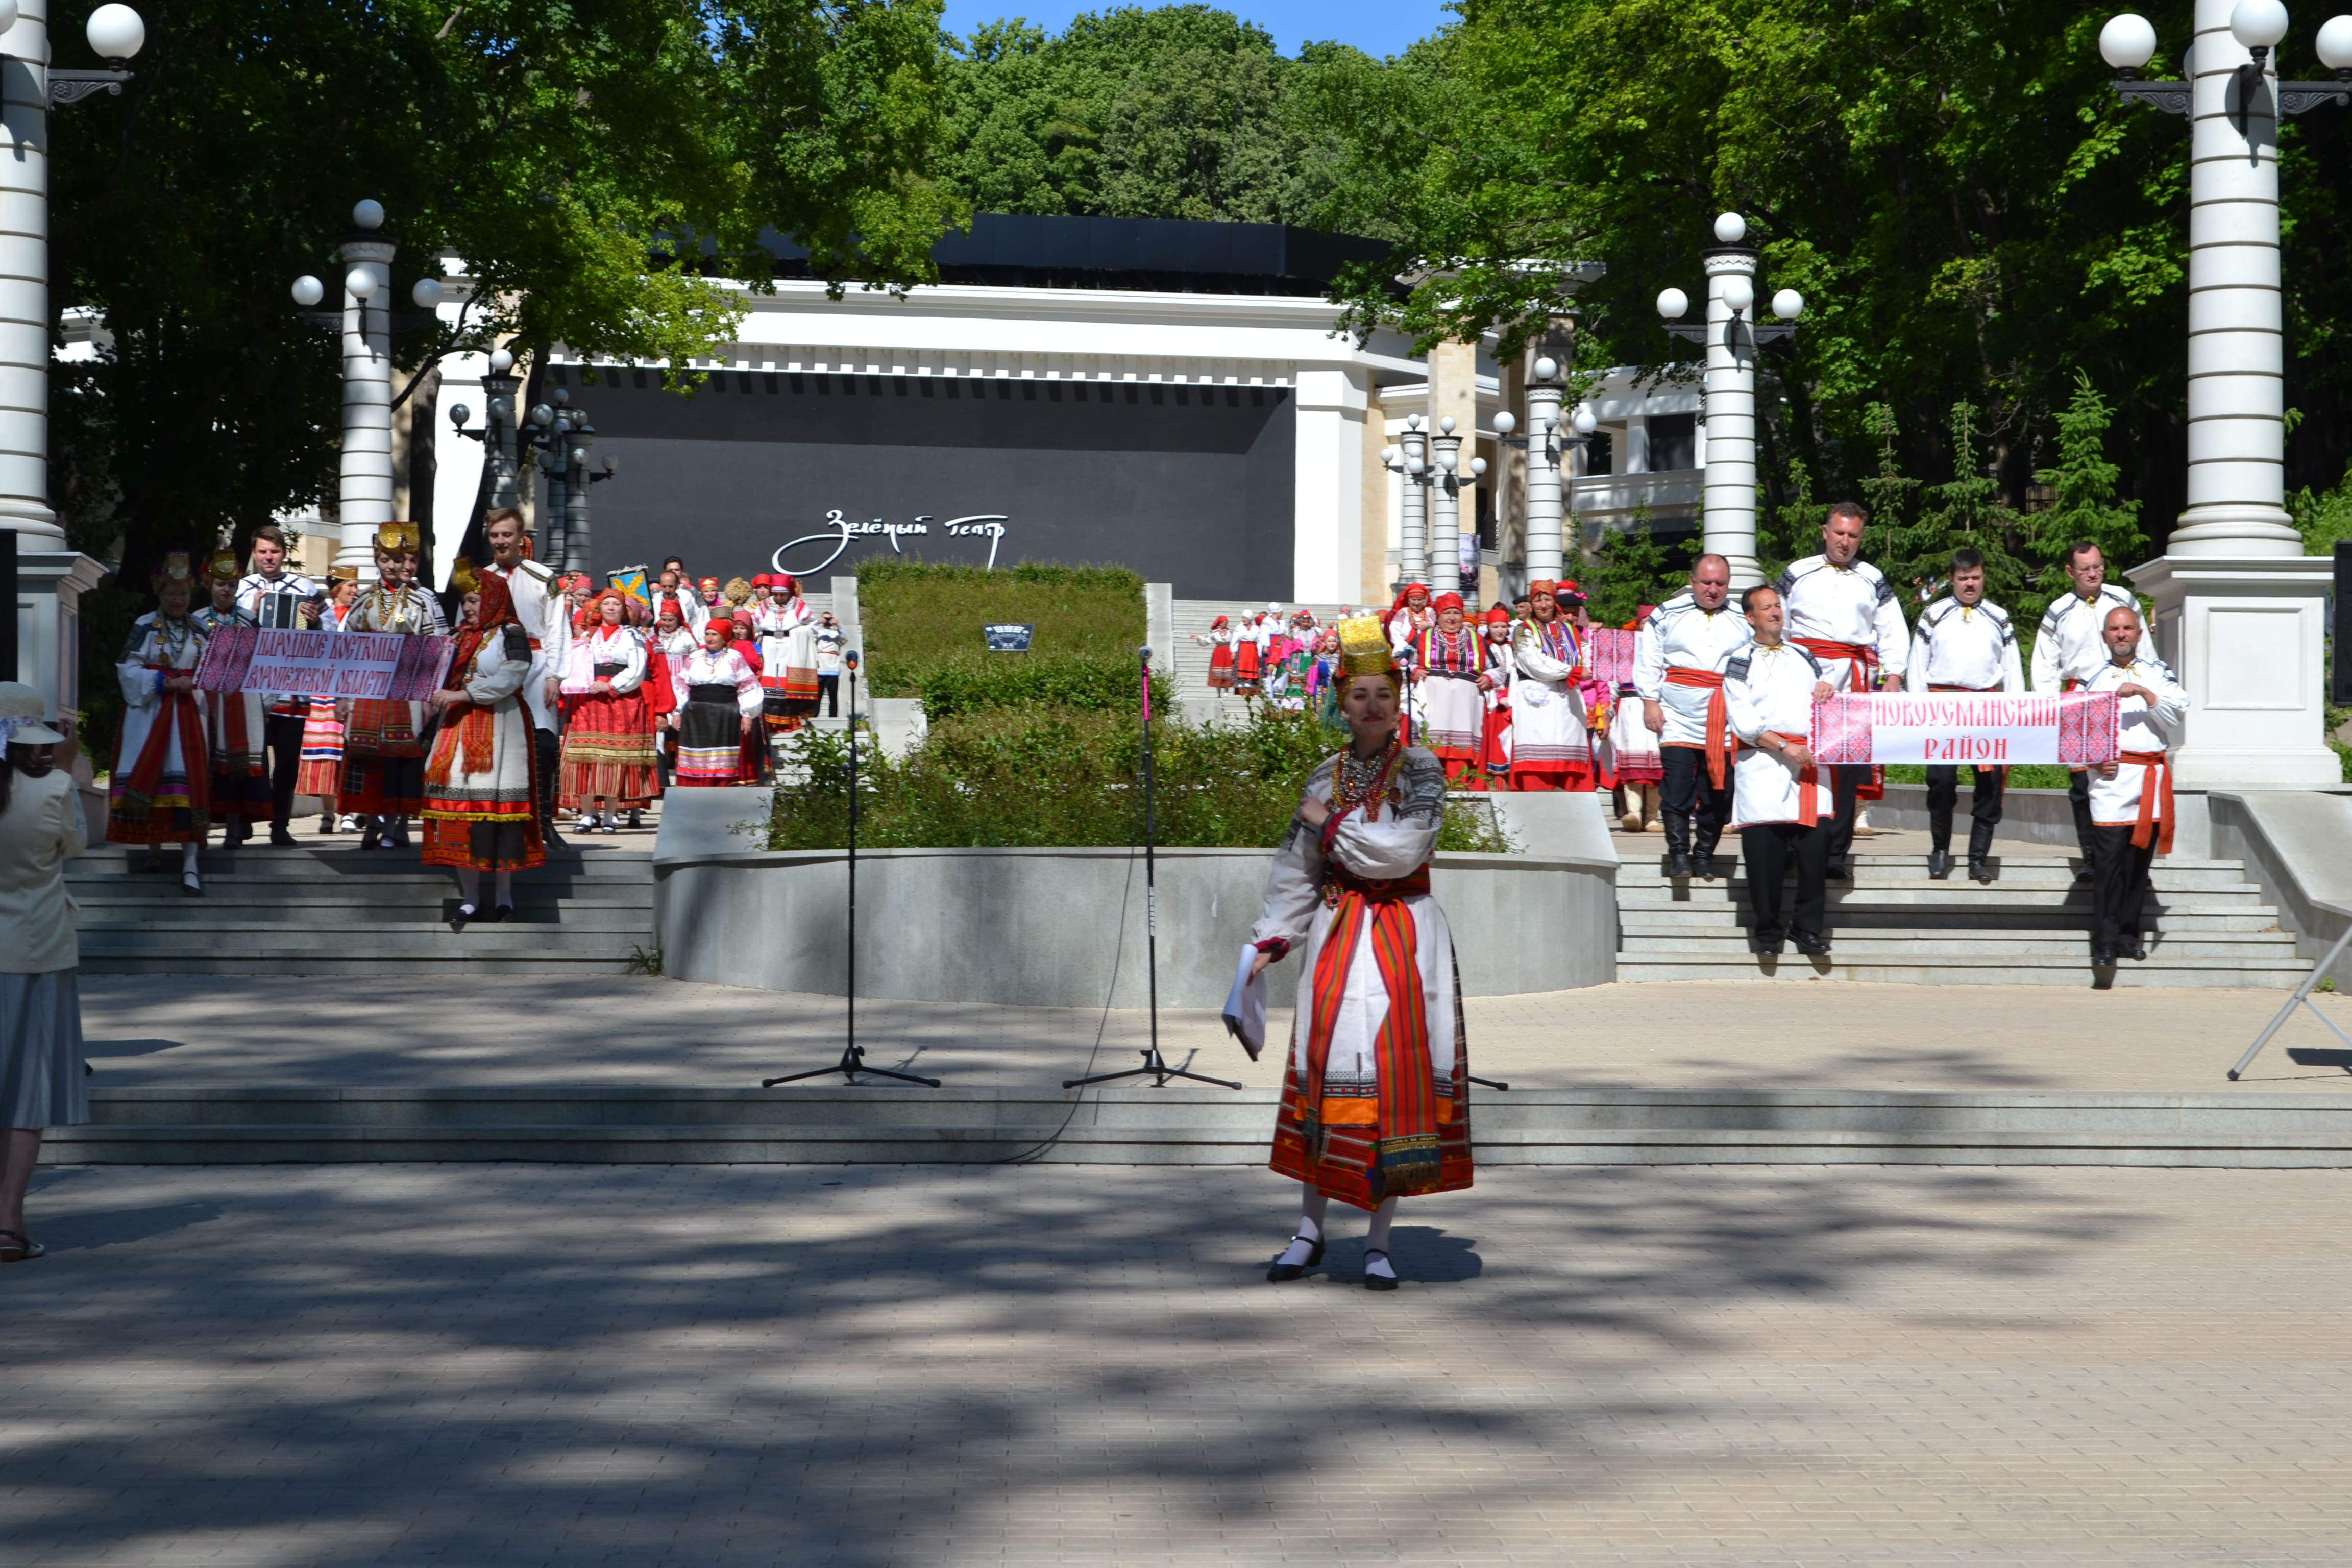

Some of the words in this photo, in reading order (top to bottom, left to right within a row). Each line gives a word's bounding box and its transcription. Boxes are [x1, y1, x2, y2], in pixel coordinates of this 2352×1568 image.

[771, 509, 933, 575] Зелёный
[256, 631, 328, 662] НАРОДНЫЕ
[329, 634, 402, 662] КОСТЮМЫ
[244, 662, 336, 693] ВОРОНЕЖСКОЙ
[335, 669, 393, 696] ОБЛАСТИ
[1875, 695, 2057, 727] НОВОУСМАНСКИЙ
[1924, 735, 2008, 760] РАЙОН
